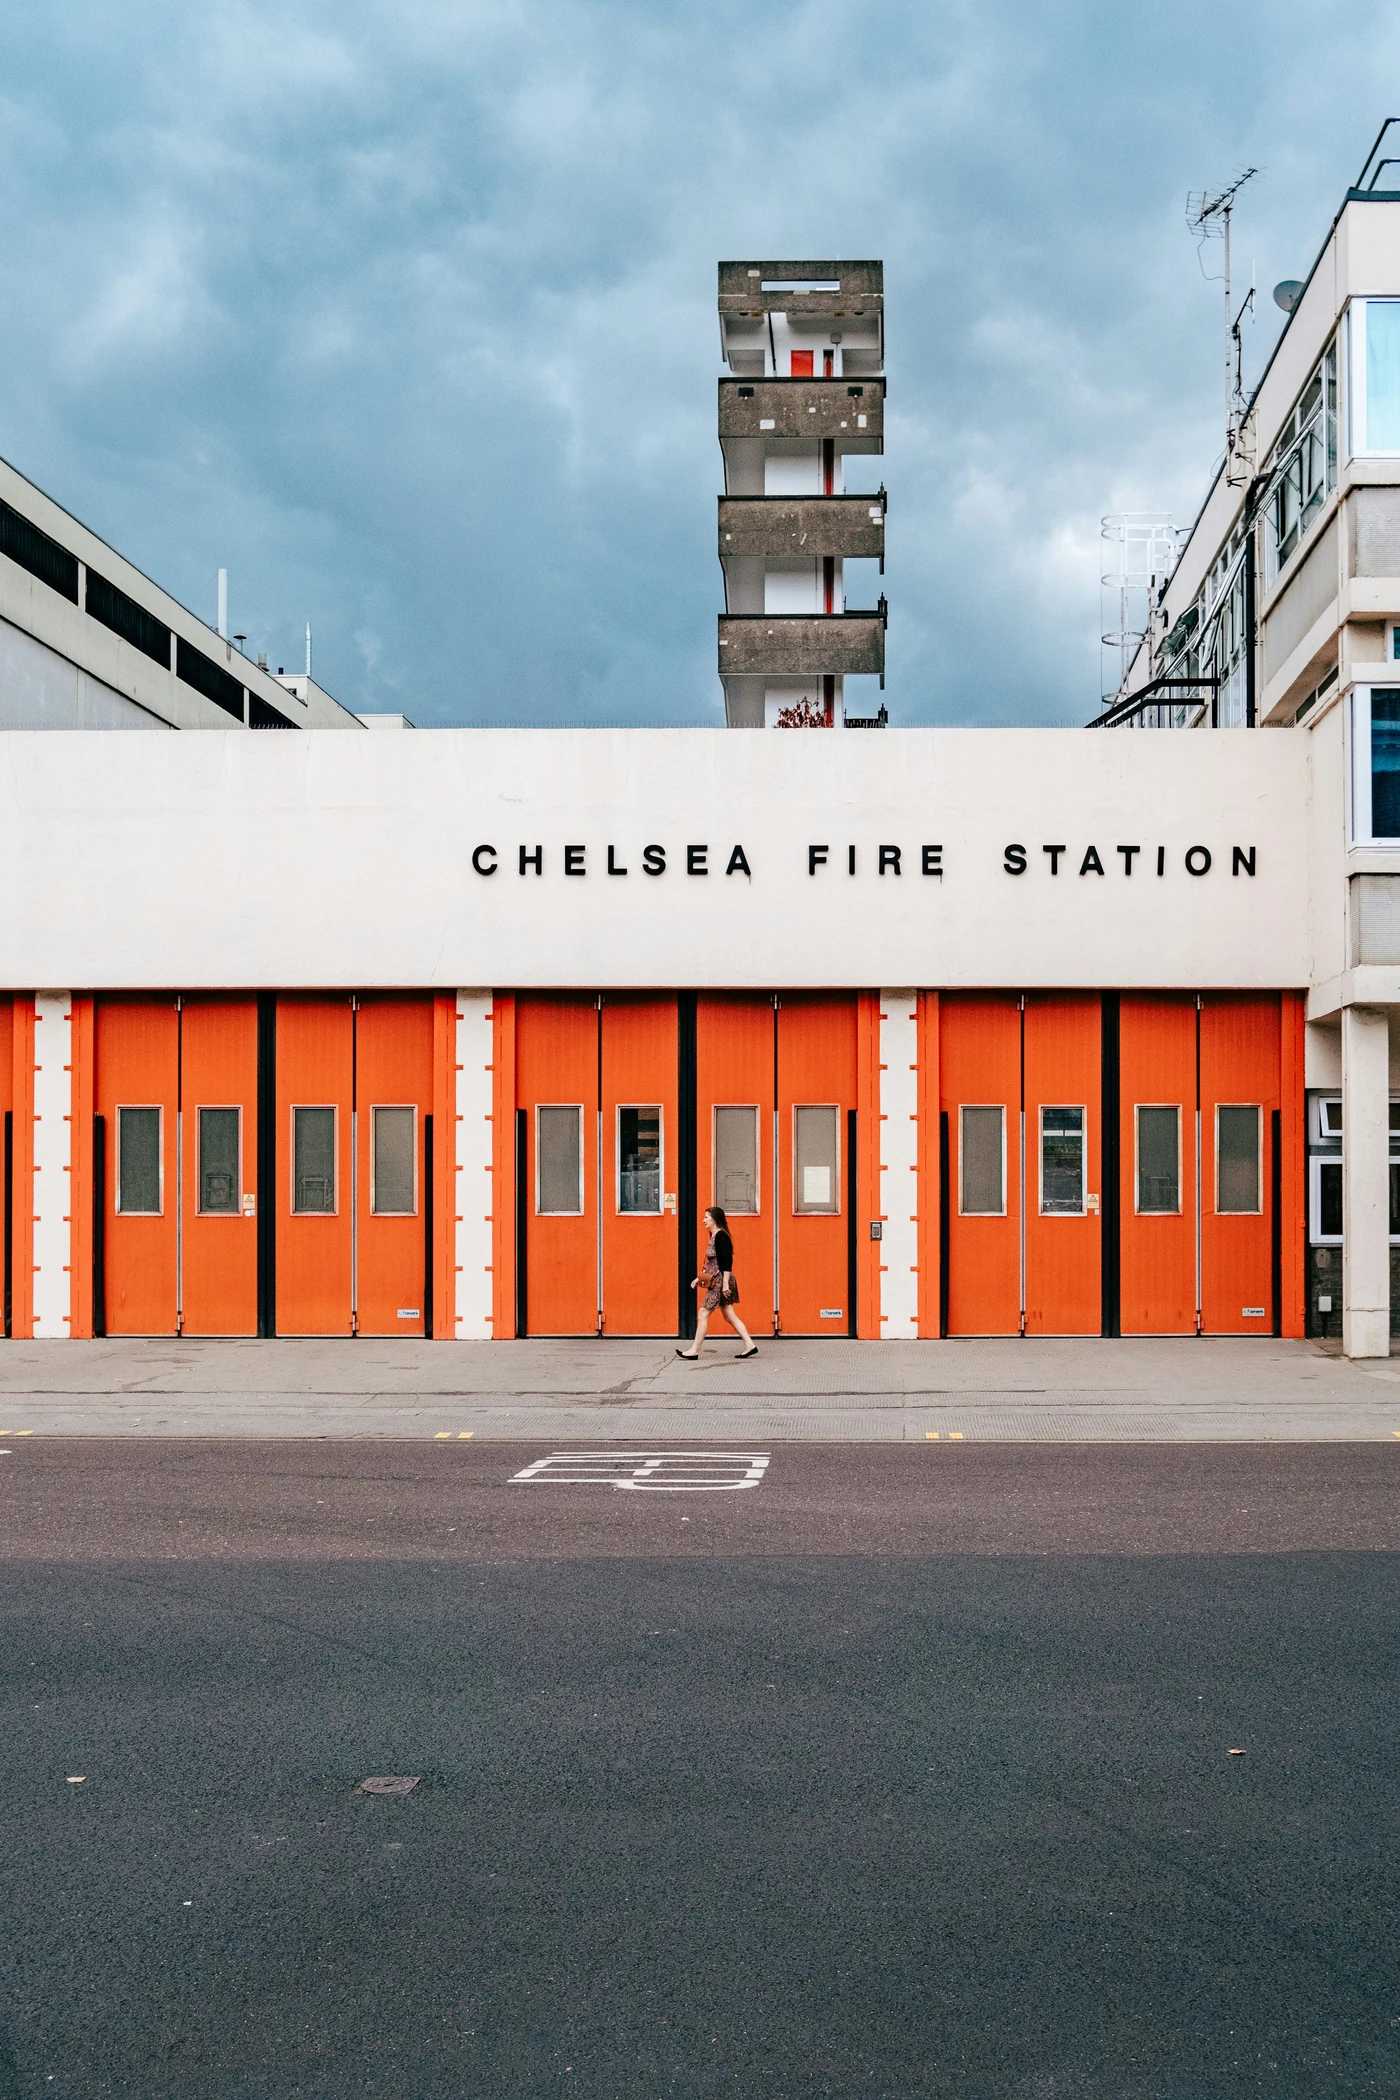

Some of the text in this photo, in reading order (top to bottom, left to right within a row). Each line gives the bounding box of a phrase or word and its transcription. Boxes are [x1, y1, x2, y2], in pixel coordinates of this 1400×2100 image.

[472, 844, 1256, 876] CHELSEA FIRE STATION
[506, 1452, 772, 1490] KEEP
